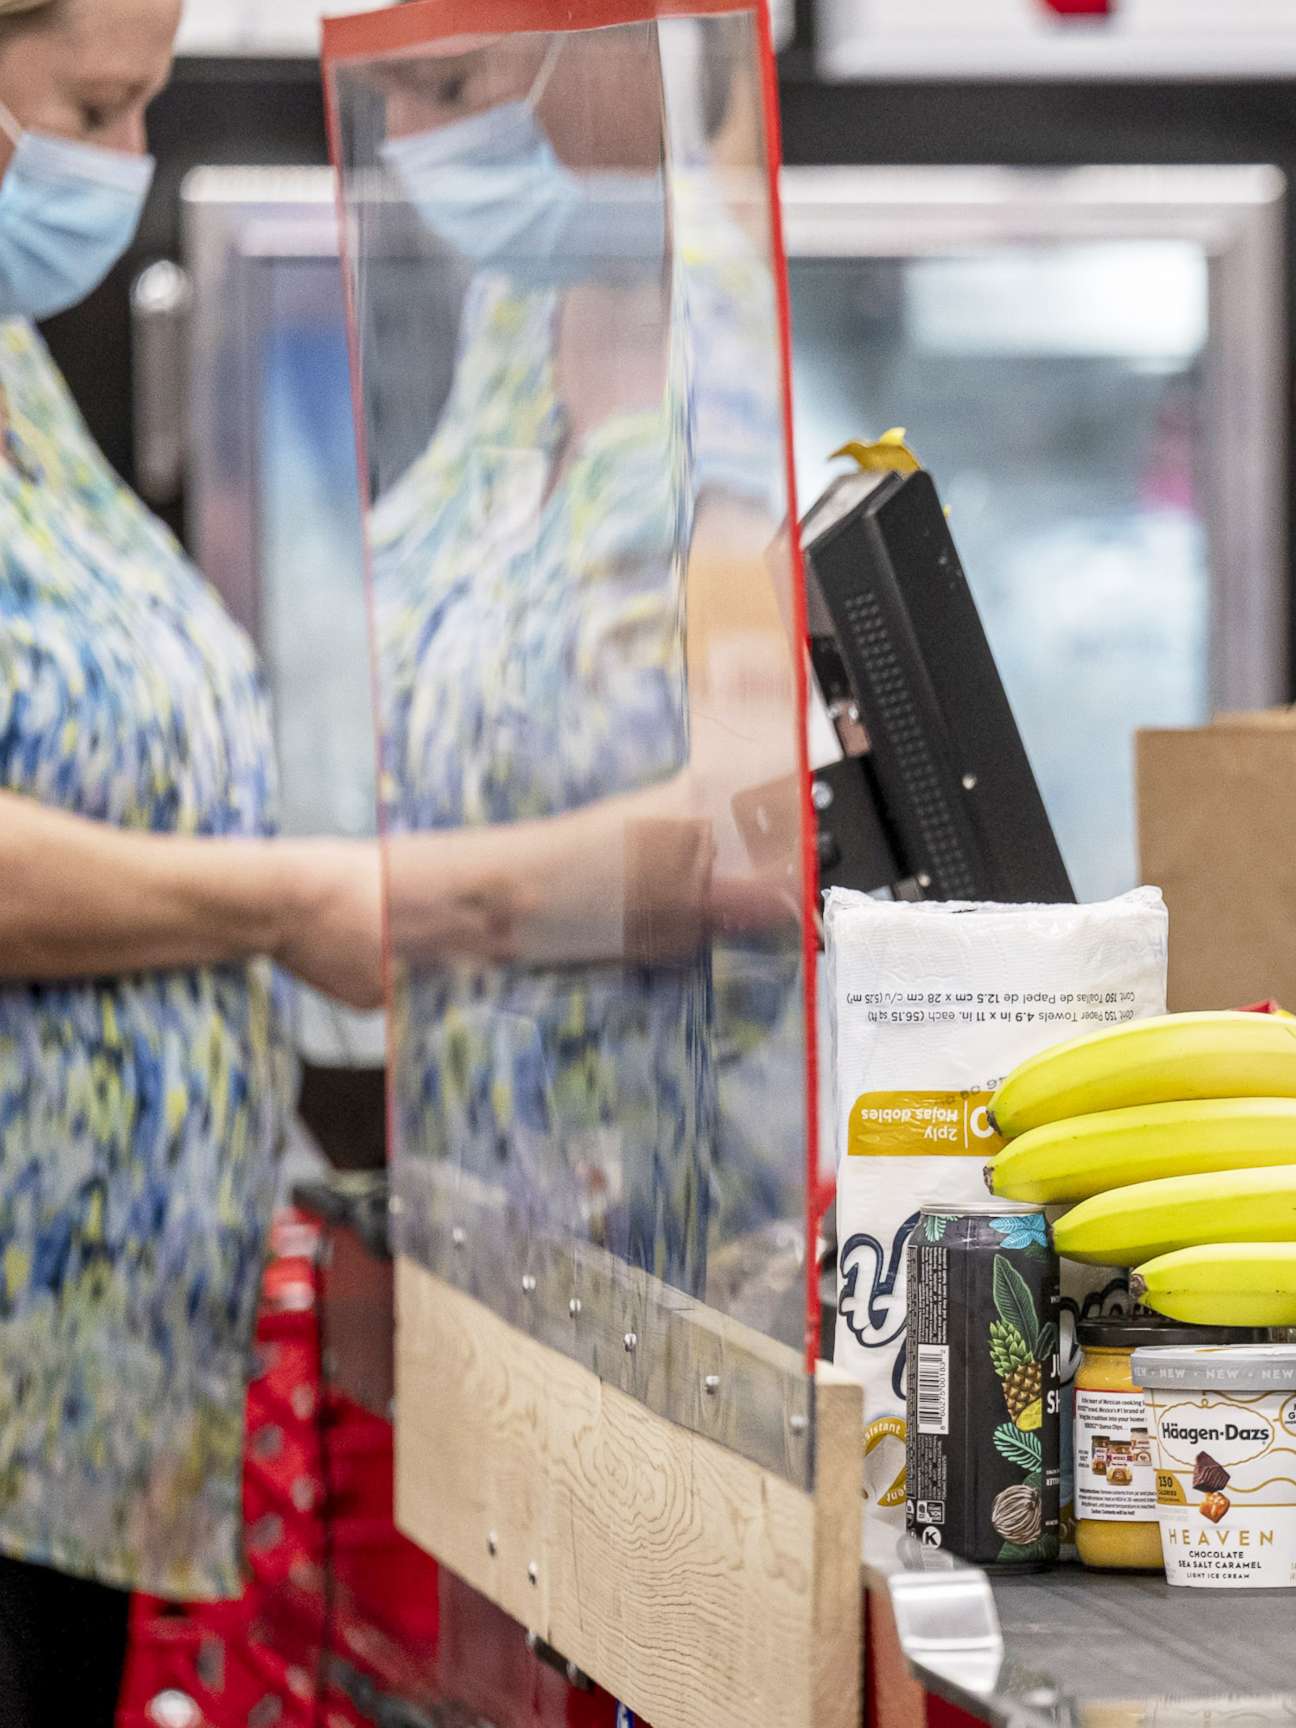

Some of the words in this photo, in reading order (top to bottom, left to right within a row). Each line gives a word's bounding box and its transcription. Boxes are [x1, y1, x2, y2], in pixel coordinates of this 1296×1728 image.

[907, 994, 923, 1002] cm
[927, 993, 941, 1003] 28
[955, 994, 973, 1002] cm
[977, 993, 1000, 1003] 12.5
[1003, 993, 1019, 1003] de
[1023, 992, 1056, 1004] Papel
[1060, 993, 1073, 1003] de
[892, 1011, 925, 1022] (56.15
[928, 1011, 955, 1022] each
[959, 1011, 972, 1022] in.
[977, 1012, 985, 1021] 11
[990, 1012, 997, 1020] x
[1001, 1012, 1011, 1022] in
[1015, 1012, 1034, 1022] 4.9
[1038, 1011, 1077, 1022] Towels
[861, 1108, 911, 1122] dobles
[916, 1107, 958, 1123] Hojas
[924, 1125, 958, 1142] 2ply
[1159, 1368, 1185, 1378] NEW
[1206, 1369, 1239, 1379] NEW
[1262, 1369, 1294, 1379] NEW
[1161, 1422, 1269, 1445] Häagen-Dazs
[1168, 1529, 1274, 1546] HEAVEN
[1188, 1550, 1244, 1559] CHOCOLATE
[1178, 1560, 1191, 1568] SEA
[1215, 1561, 1262, 1569] CARAMEL
